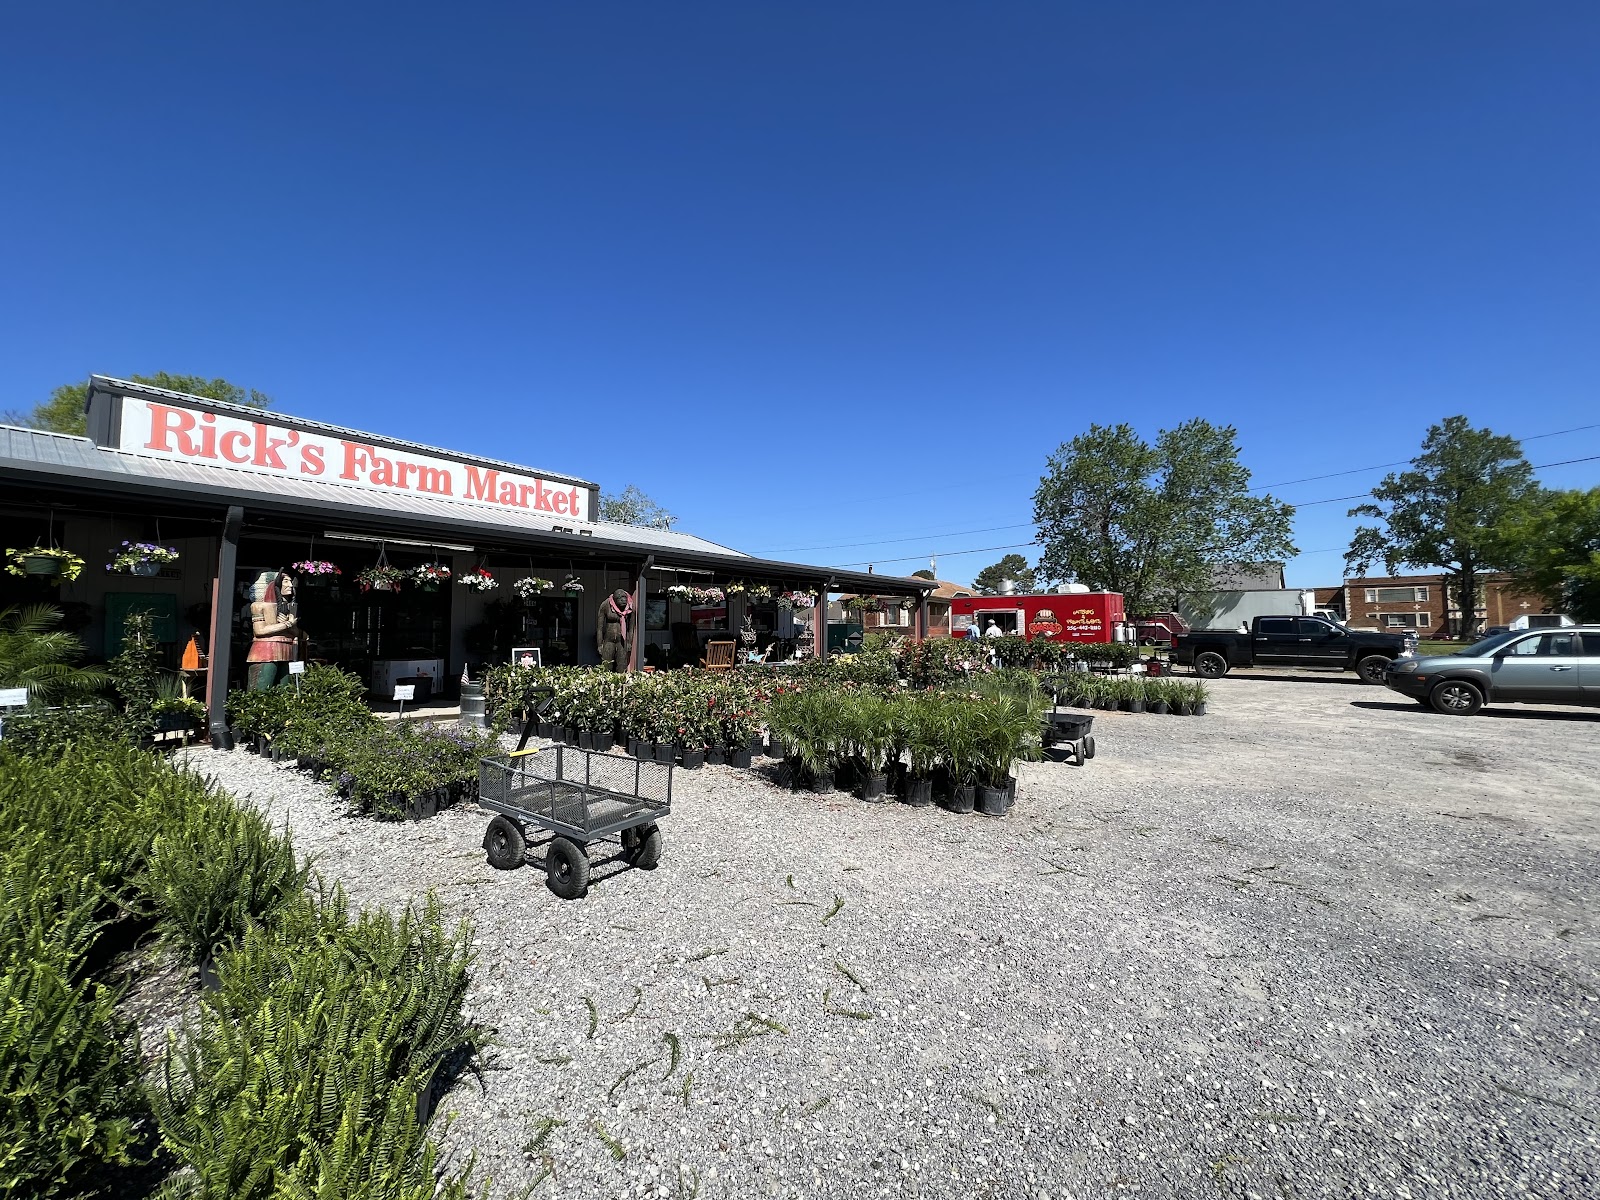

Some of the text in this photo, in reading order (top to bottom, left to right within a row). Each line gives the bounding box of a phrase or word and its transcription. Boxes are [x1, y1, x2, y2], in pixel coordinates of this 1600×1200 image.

[145, 403, 581, 517] Rick's Farm Market
